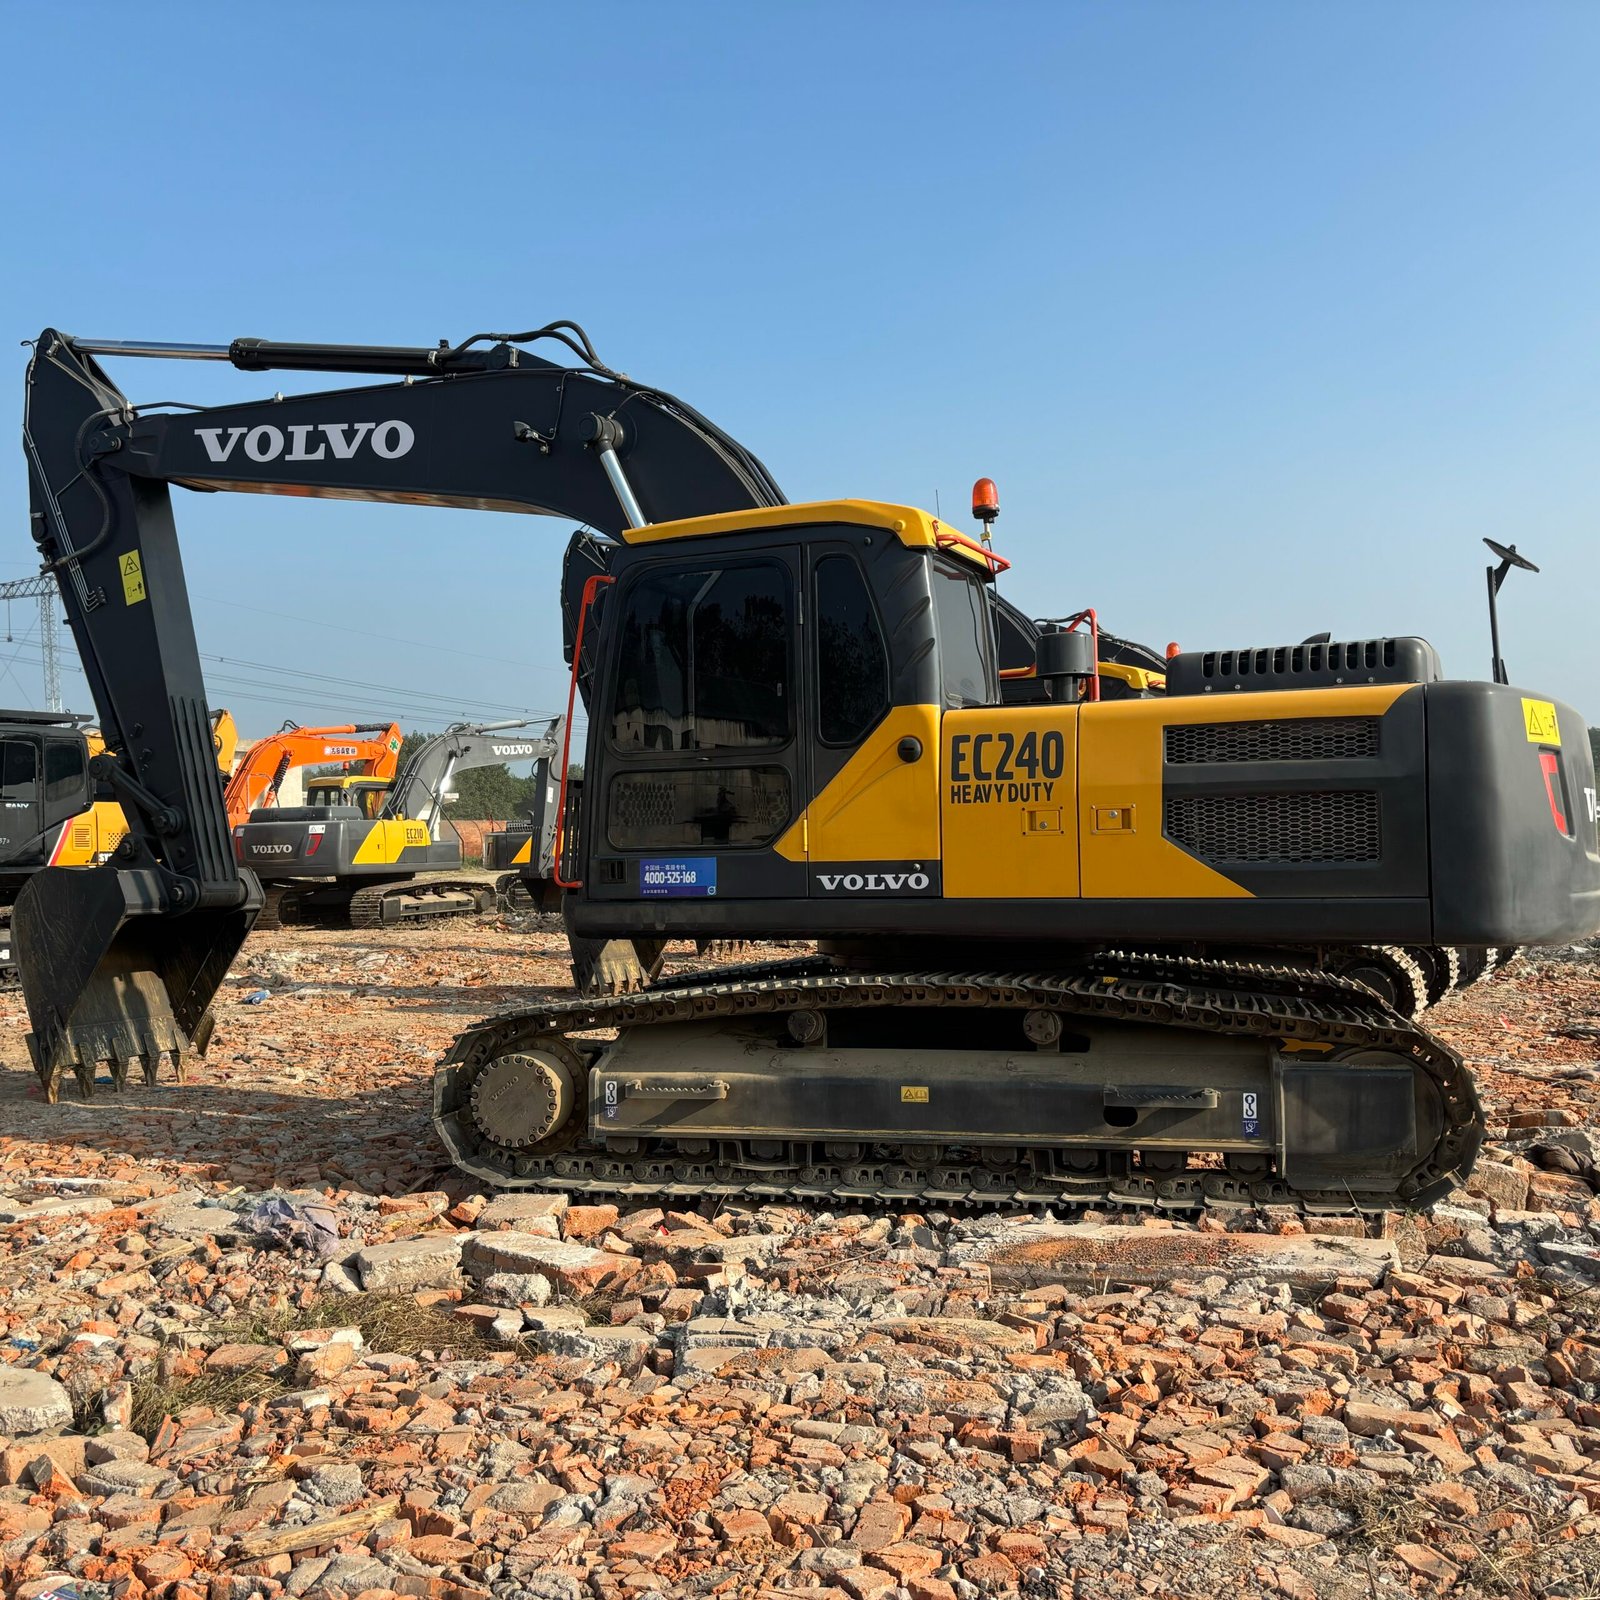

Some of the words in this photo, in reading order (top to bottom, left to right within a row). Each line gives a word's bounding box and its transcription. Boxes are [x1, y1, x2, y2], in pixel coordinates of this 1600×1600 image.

[194, 420, 415, 463] VOLVO
[491, 744, 533, 756] VOLVO
[951, 730, 1065, 782] EC240
[951, 783, 1004, 804] HEAVY
[1008, 782, 1054, 803] DUTY
[251, 844, 293, 855] VOLVO
[643, 871, 697, 884] 4000-525-168
[816, 872, 930, 891] VOLVO
